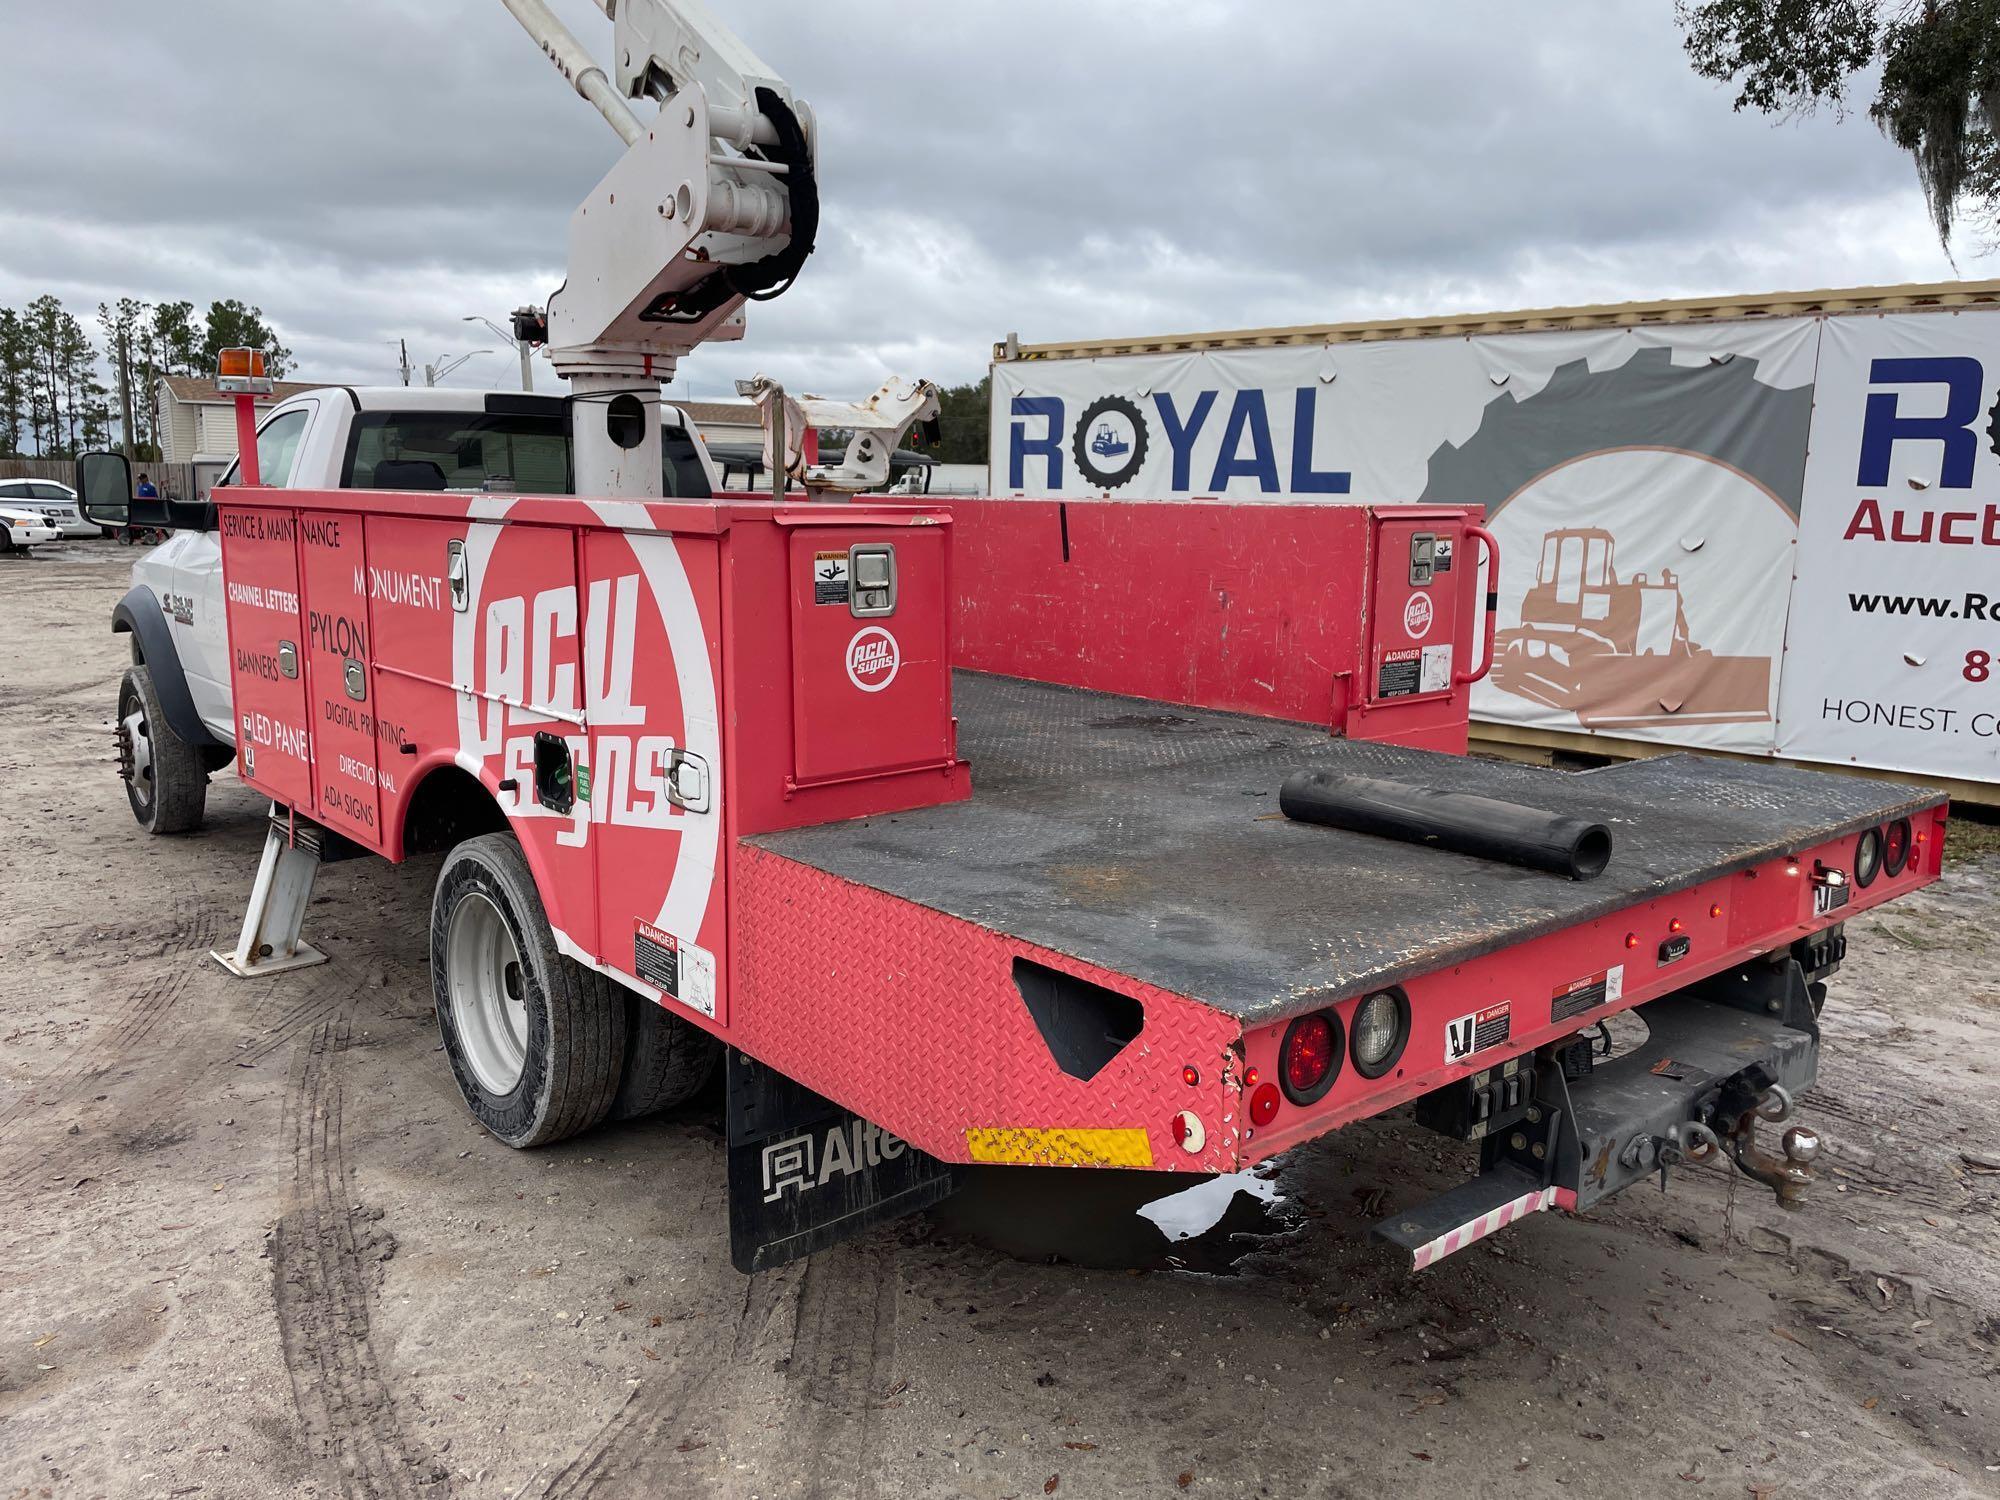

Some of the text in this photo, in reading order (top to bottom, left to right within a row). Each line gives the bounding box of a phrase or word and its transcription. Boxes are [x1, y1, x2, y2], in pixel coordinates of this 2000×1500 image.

[224, 514, 256, 540] SERVICE
[258, 518, 265, 540] &
[228, 582, 298, 615] CHANNEL LETTERS
[309, 611, 366, 660] PYLON
[237, 649, 279, 682] BANNERS
[857, 656, 893, 675] signs
[1392, 650, 1420, 661] DANGER
[325, 700, 406, 747] DIGITAL PRINTING
[1822, 698, 1959, 734] HONEST.
[251, 711, 272, 746] LED
[274, 720, 316, 764] PANEL
[340, 754, 397, 794] DIRECTIONAL
[324, 784, 374, 827] ADA SIGNS
[645, 925, 675, 950] DANGER
[1573, 977, 1593, 990] DANGER
[1486, 1004, 1510, 1019] DANGER
